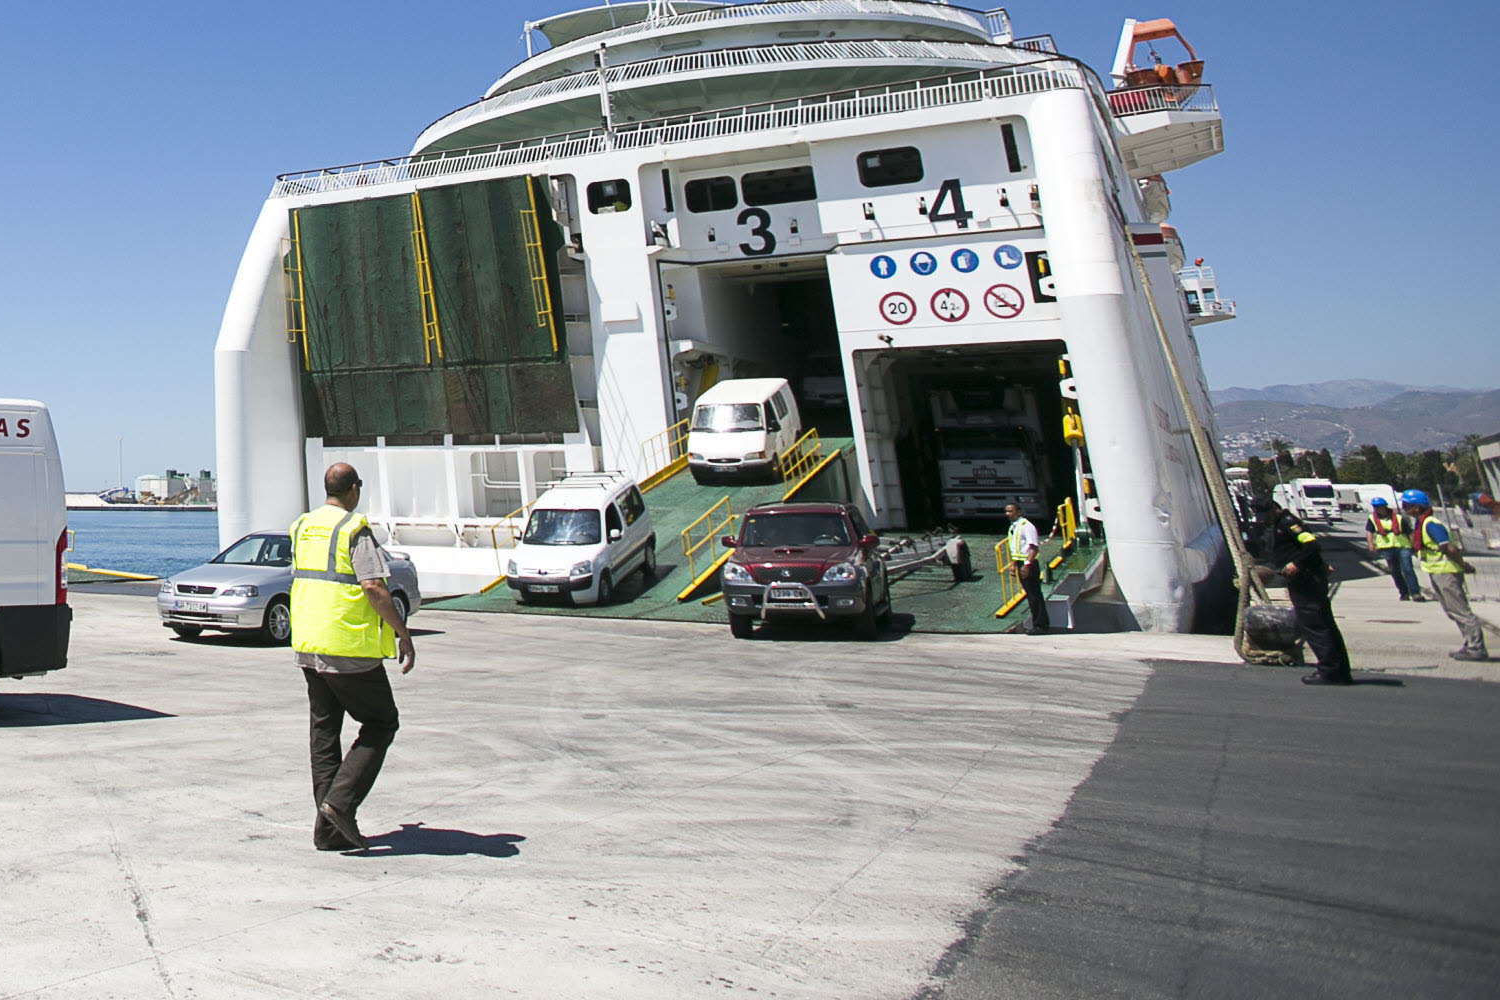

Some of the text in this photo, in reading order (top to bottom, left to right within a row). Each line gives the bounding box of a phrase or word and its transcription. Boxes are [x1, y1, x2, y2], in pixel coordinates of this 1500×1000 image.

[929, 178, 973, 229] 4
[736, 207, 776, 256] 3
[888, 302, 908, 315] 20
